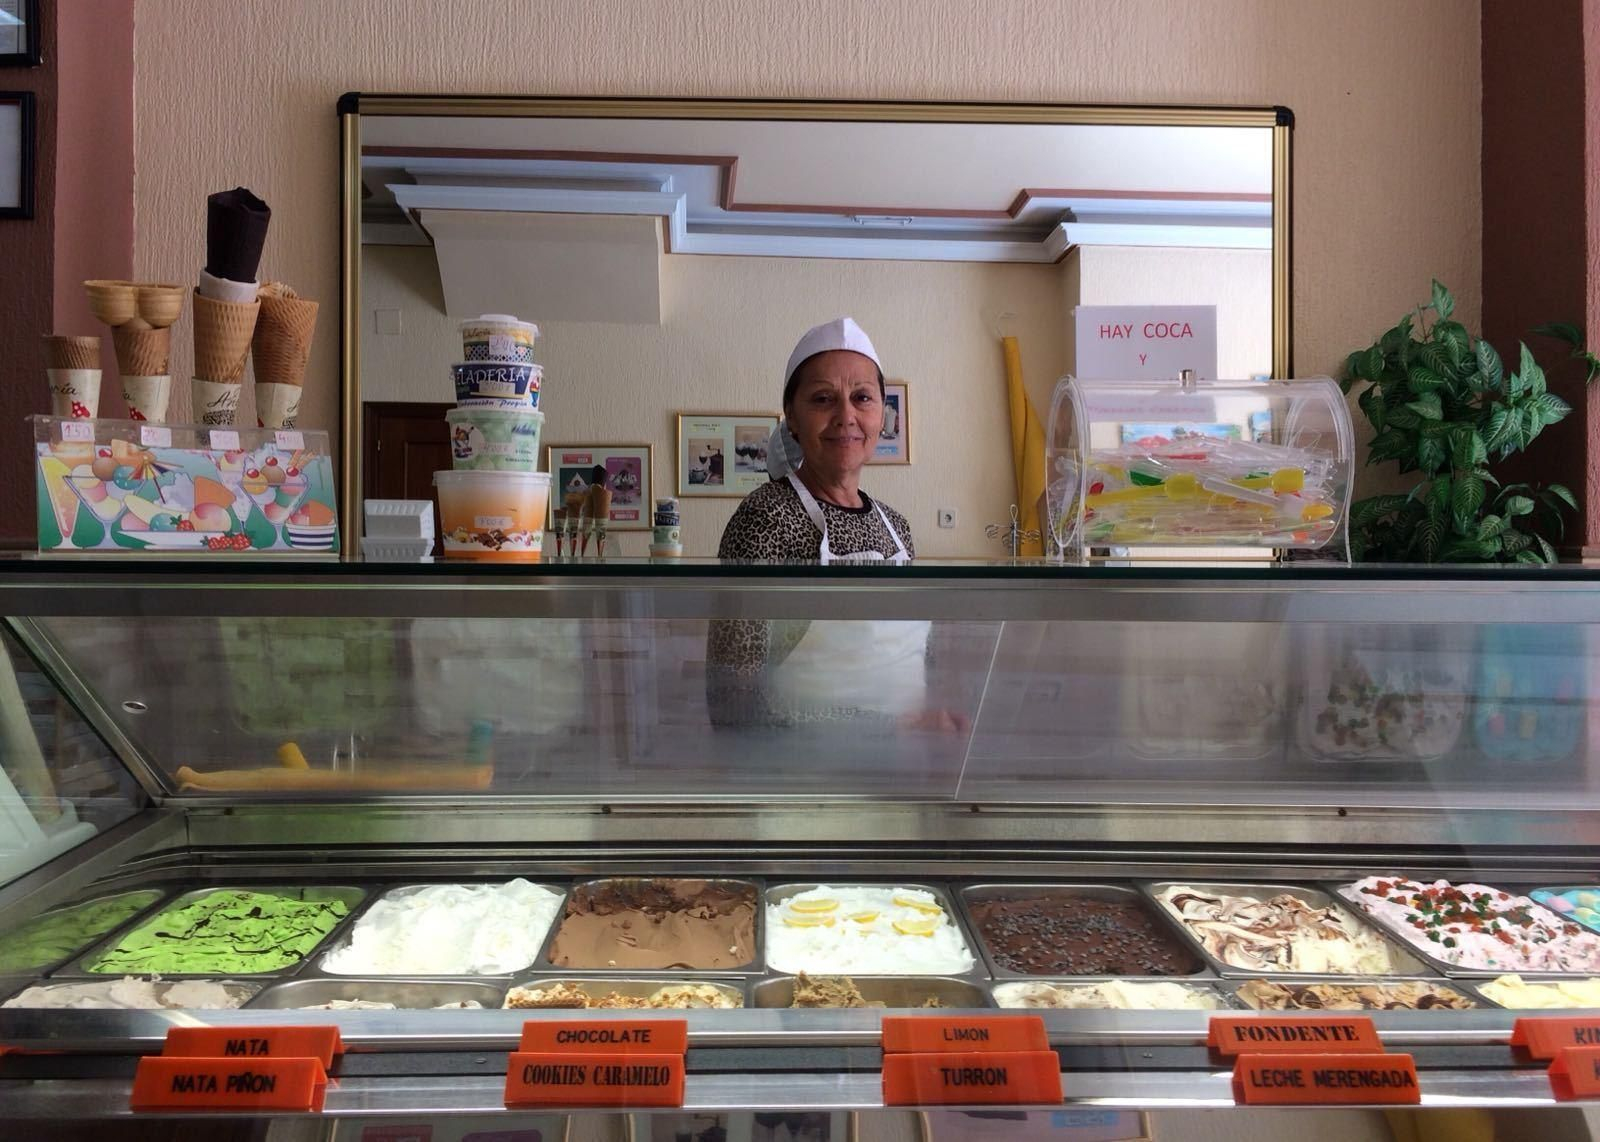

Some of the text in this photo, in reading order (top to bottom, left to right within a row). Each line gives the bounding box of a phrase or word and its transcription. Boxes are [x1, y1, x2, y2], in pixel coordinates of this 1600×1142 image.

[1100, 322, 1193, 339] HAY COCA
[1139, 353, 1147, 366] Y
[557, 1029, 652, 1044] CHOCOLATE
[943, 1028, 990, 1042] LIMON
[1233, 1025, 1360, 1042] FONDENTE
[225, 1039, 270, 1056] NATA
[172, 1071, 277, 1093] NATA PIÑON
[523, 1064, 671, 1086] COOKIES CARAMELO
[940, 1067, 1008, 1086] TURRON
[1250, 1069, 1416, 1089] LECHE MERENGADA
